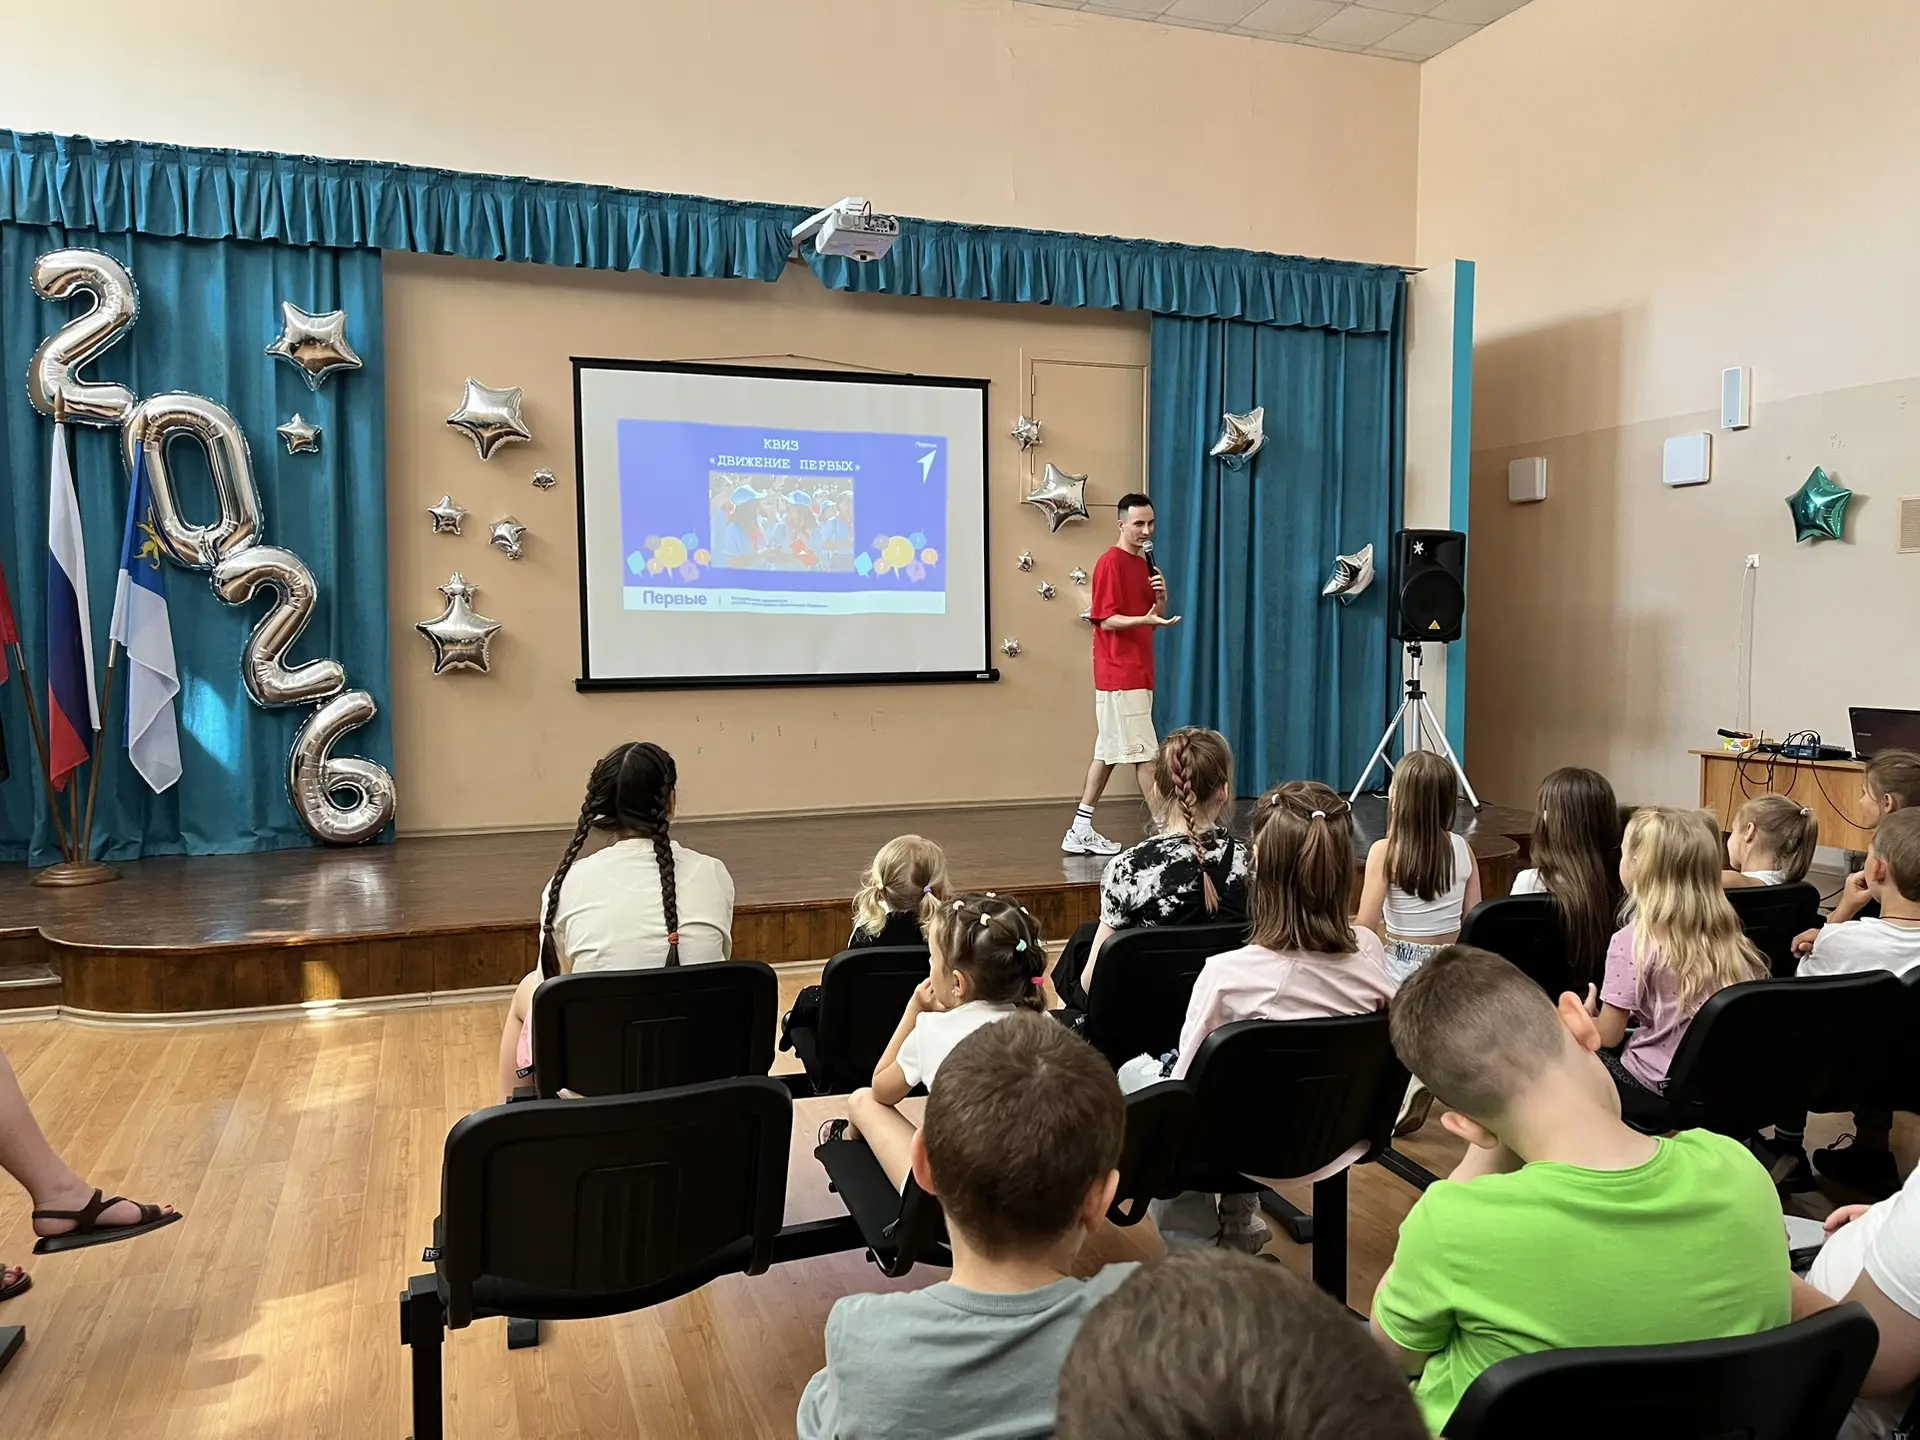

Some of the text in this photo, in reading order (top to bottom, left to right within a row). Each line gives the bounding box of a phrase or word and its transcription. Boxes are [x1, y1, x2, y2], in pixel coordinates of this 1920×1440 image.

[763, 438, 800, 452] КВИЗ
[709, 455, 861, 472] «ДВИЖЕНИЕ ПЕРВЫХ»
[27, 246, 397, 845] 2026
[642, 590, 708, 608] Первые
